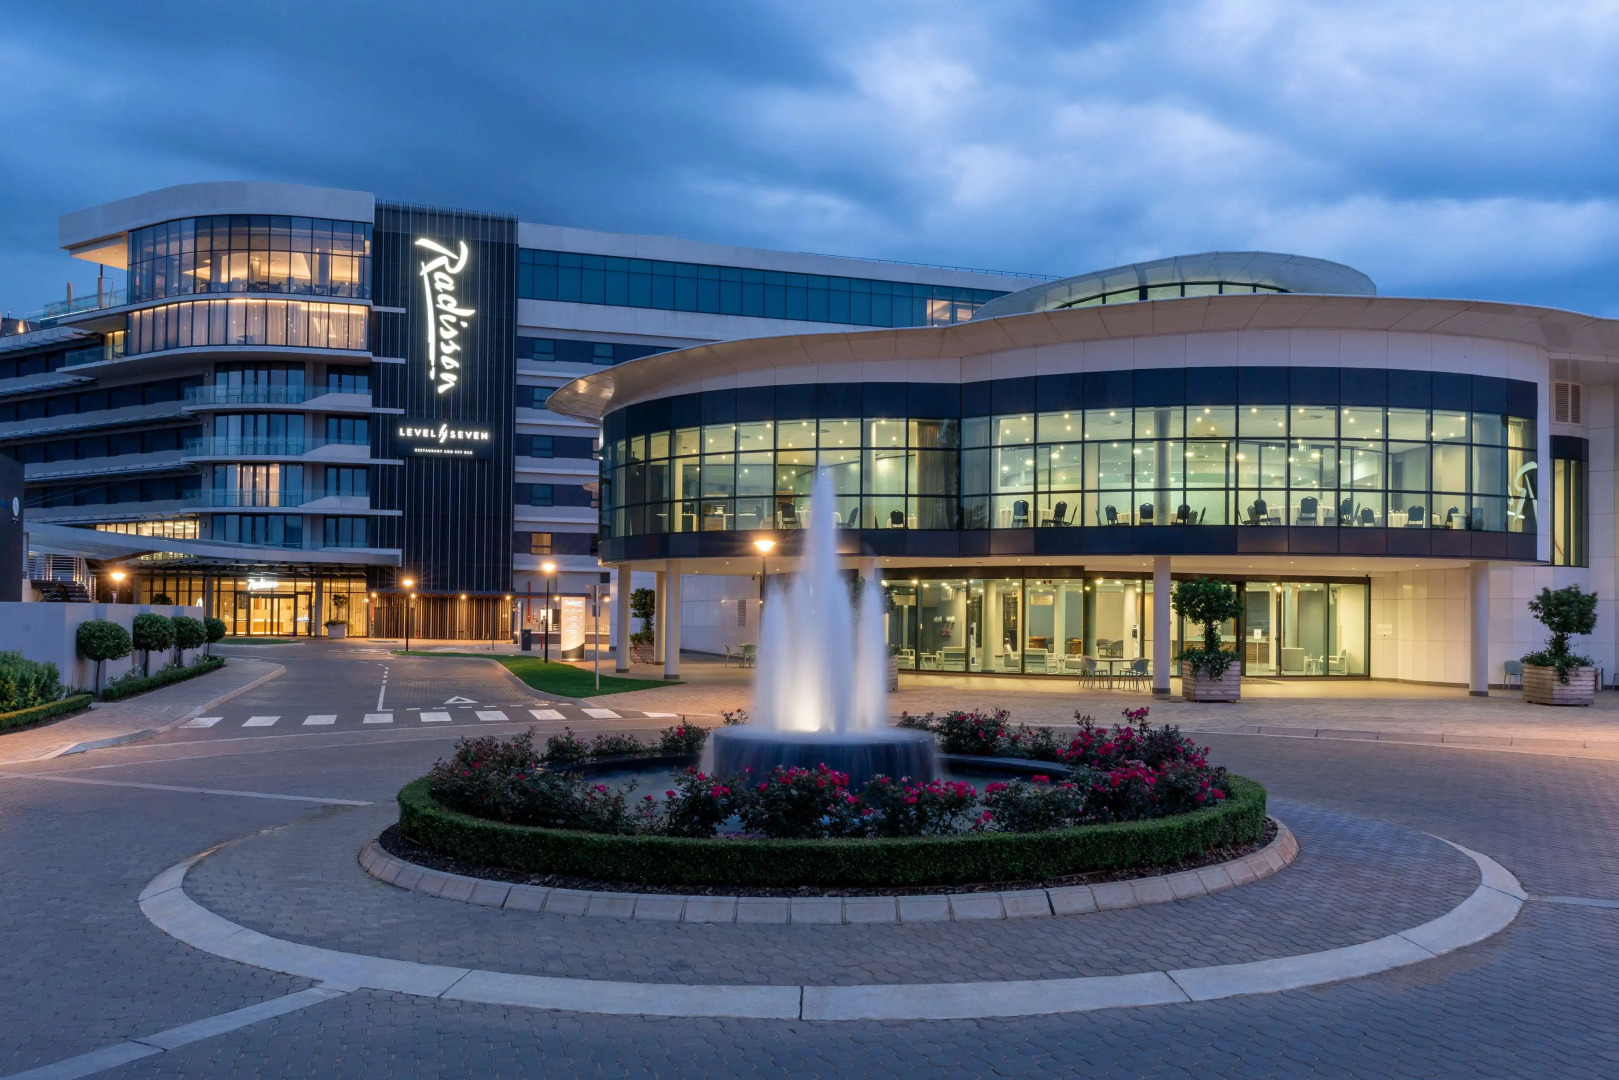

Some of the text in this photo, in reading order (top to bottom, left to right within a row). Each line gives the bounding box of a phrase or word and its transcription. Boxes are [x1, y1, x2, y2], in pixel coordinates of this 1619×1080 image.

[415, 238, 475, 393] Radisson
[399, 428, 489, 440] LEVEL SEVEN
